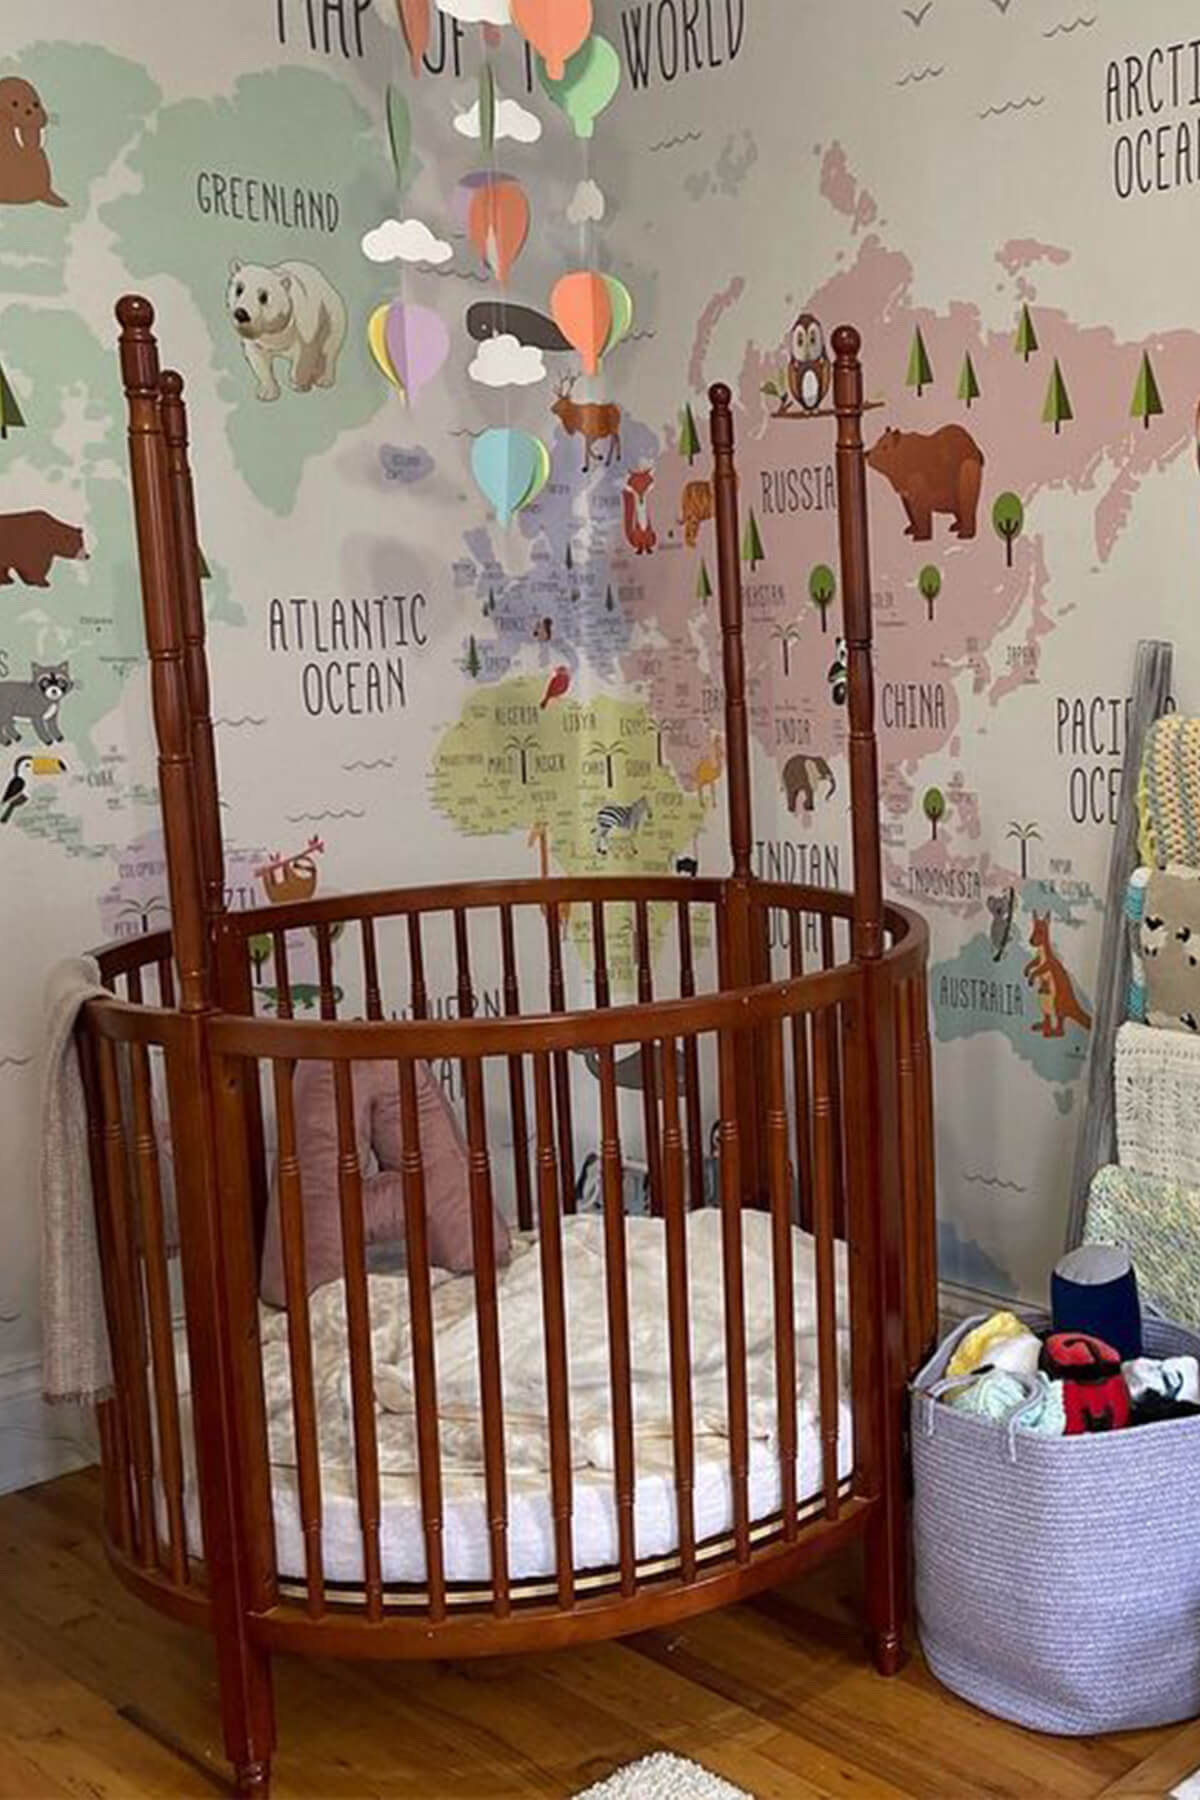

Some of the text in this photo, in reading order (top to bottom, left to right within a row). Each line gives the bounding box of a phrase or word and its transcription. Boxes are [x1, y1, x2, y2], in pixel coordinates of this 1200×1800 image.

[621, 0, 745, 90] WORLD
[1106, 40, 1200, 124] ARCTI
[1114, 118, 1200, 198] OCEA
[197, 172, 339, 233] GREENLAND
[760, 464, 837, 514] RUSSIA
[269, 593, 428, 652] ATLANTIC
[302, 657, 406, 716] OCEAN
[882, 683, 947, 729] CHINA
[562, 711, 597, 733] LIBYA
[774, 718, 812, 745] INDIA
[1069, 766, 1123, 824] OCE
[907, 866, 981, 899] INDONESIA
[939, 976, 1024, 1017] AUSTRALIA
